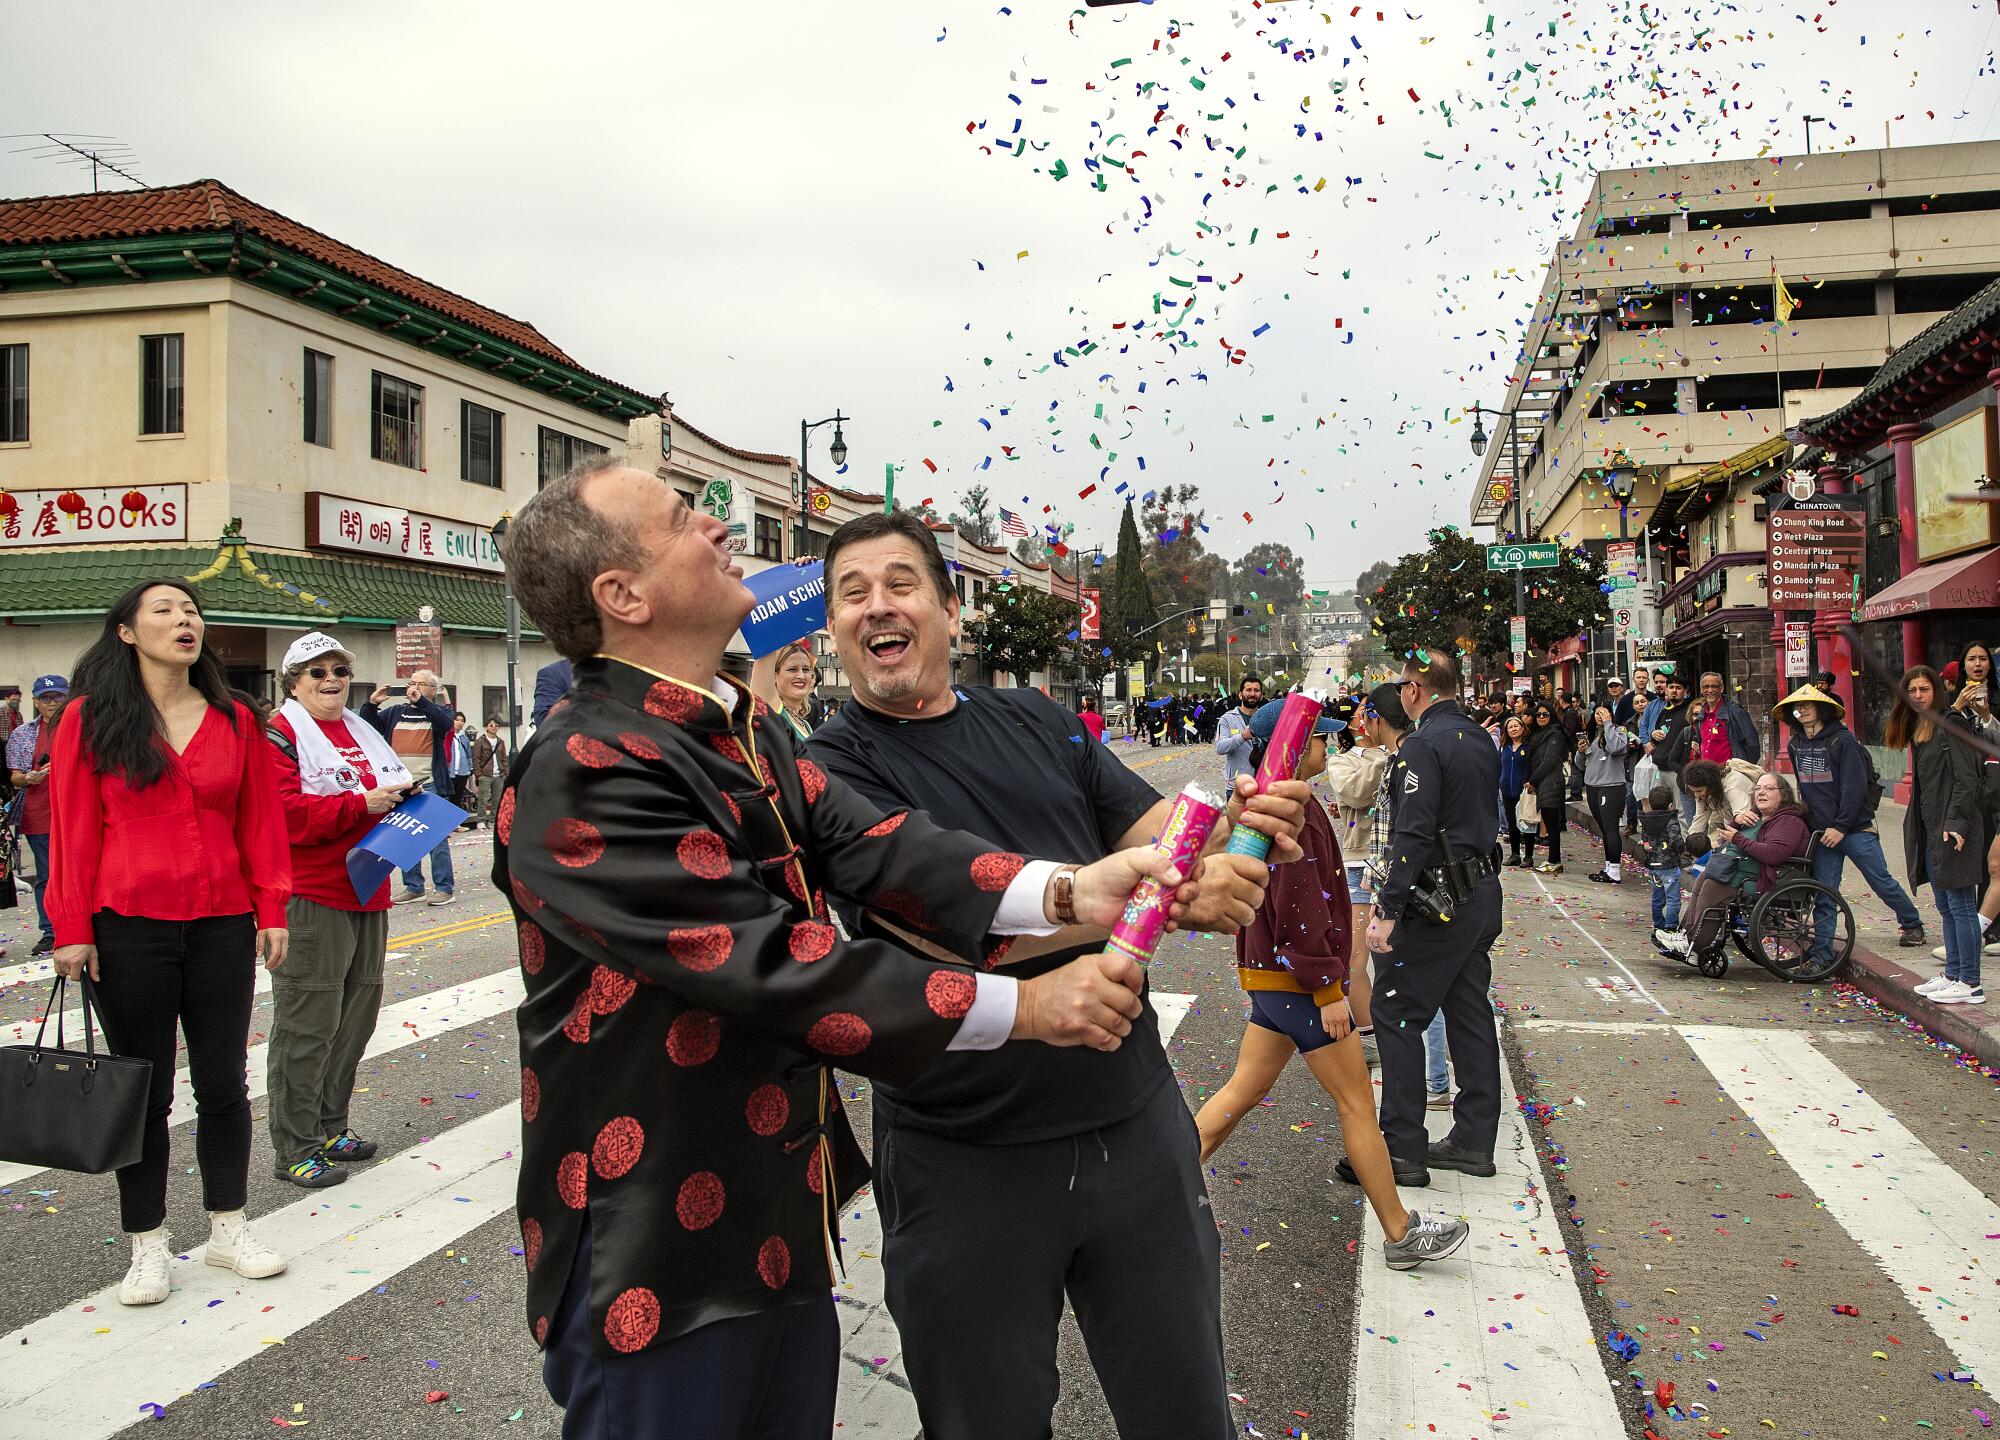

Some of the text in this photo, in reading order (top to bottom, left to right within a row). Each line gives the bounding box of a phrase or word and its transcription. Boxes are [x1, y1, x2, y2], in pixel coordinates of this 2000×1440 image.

[1794, 502, 1841, 510] CHINATOWN
[77, 502, 177, 530] BOOKS
[1783, 519, 1806, 527] Chung
[1808, 519, 1824, 527] King
[1784, 533, 1824, 541] West Plaza
[1784, 547, 1833, 555] Central Plaza
[1510, 552, 1521, 561] 110
[1784, 591, 1860, 600] Chinese Hist Sociey
[750, 595, 789, 625] ADAM
[44, 678, 55, 686] LA
[1417, 1236, 1434, 1251] N
